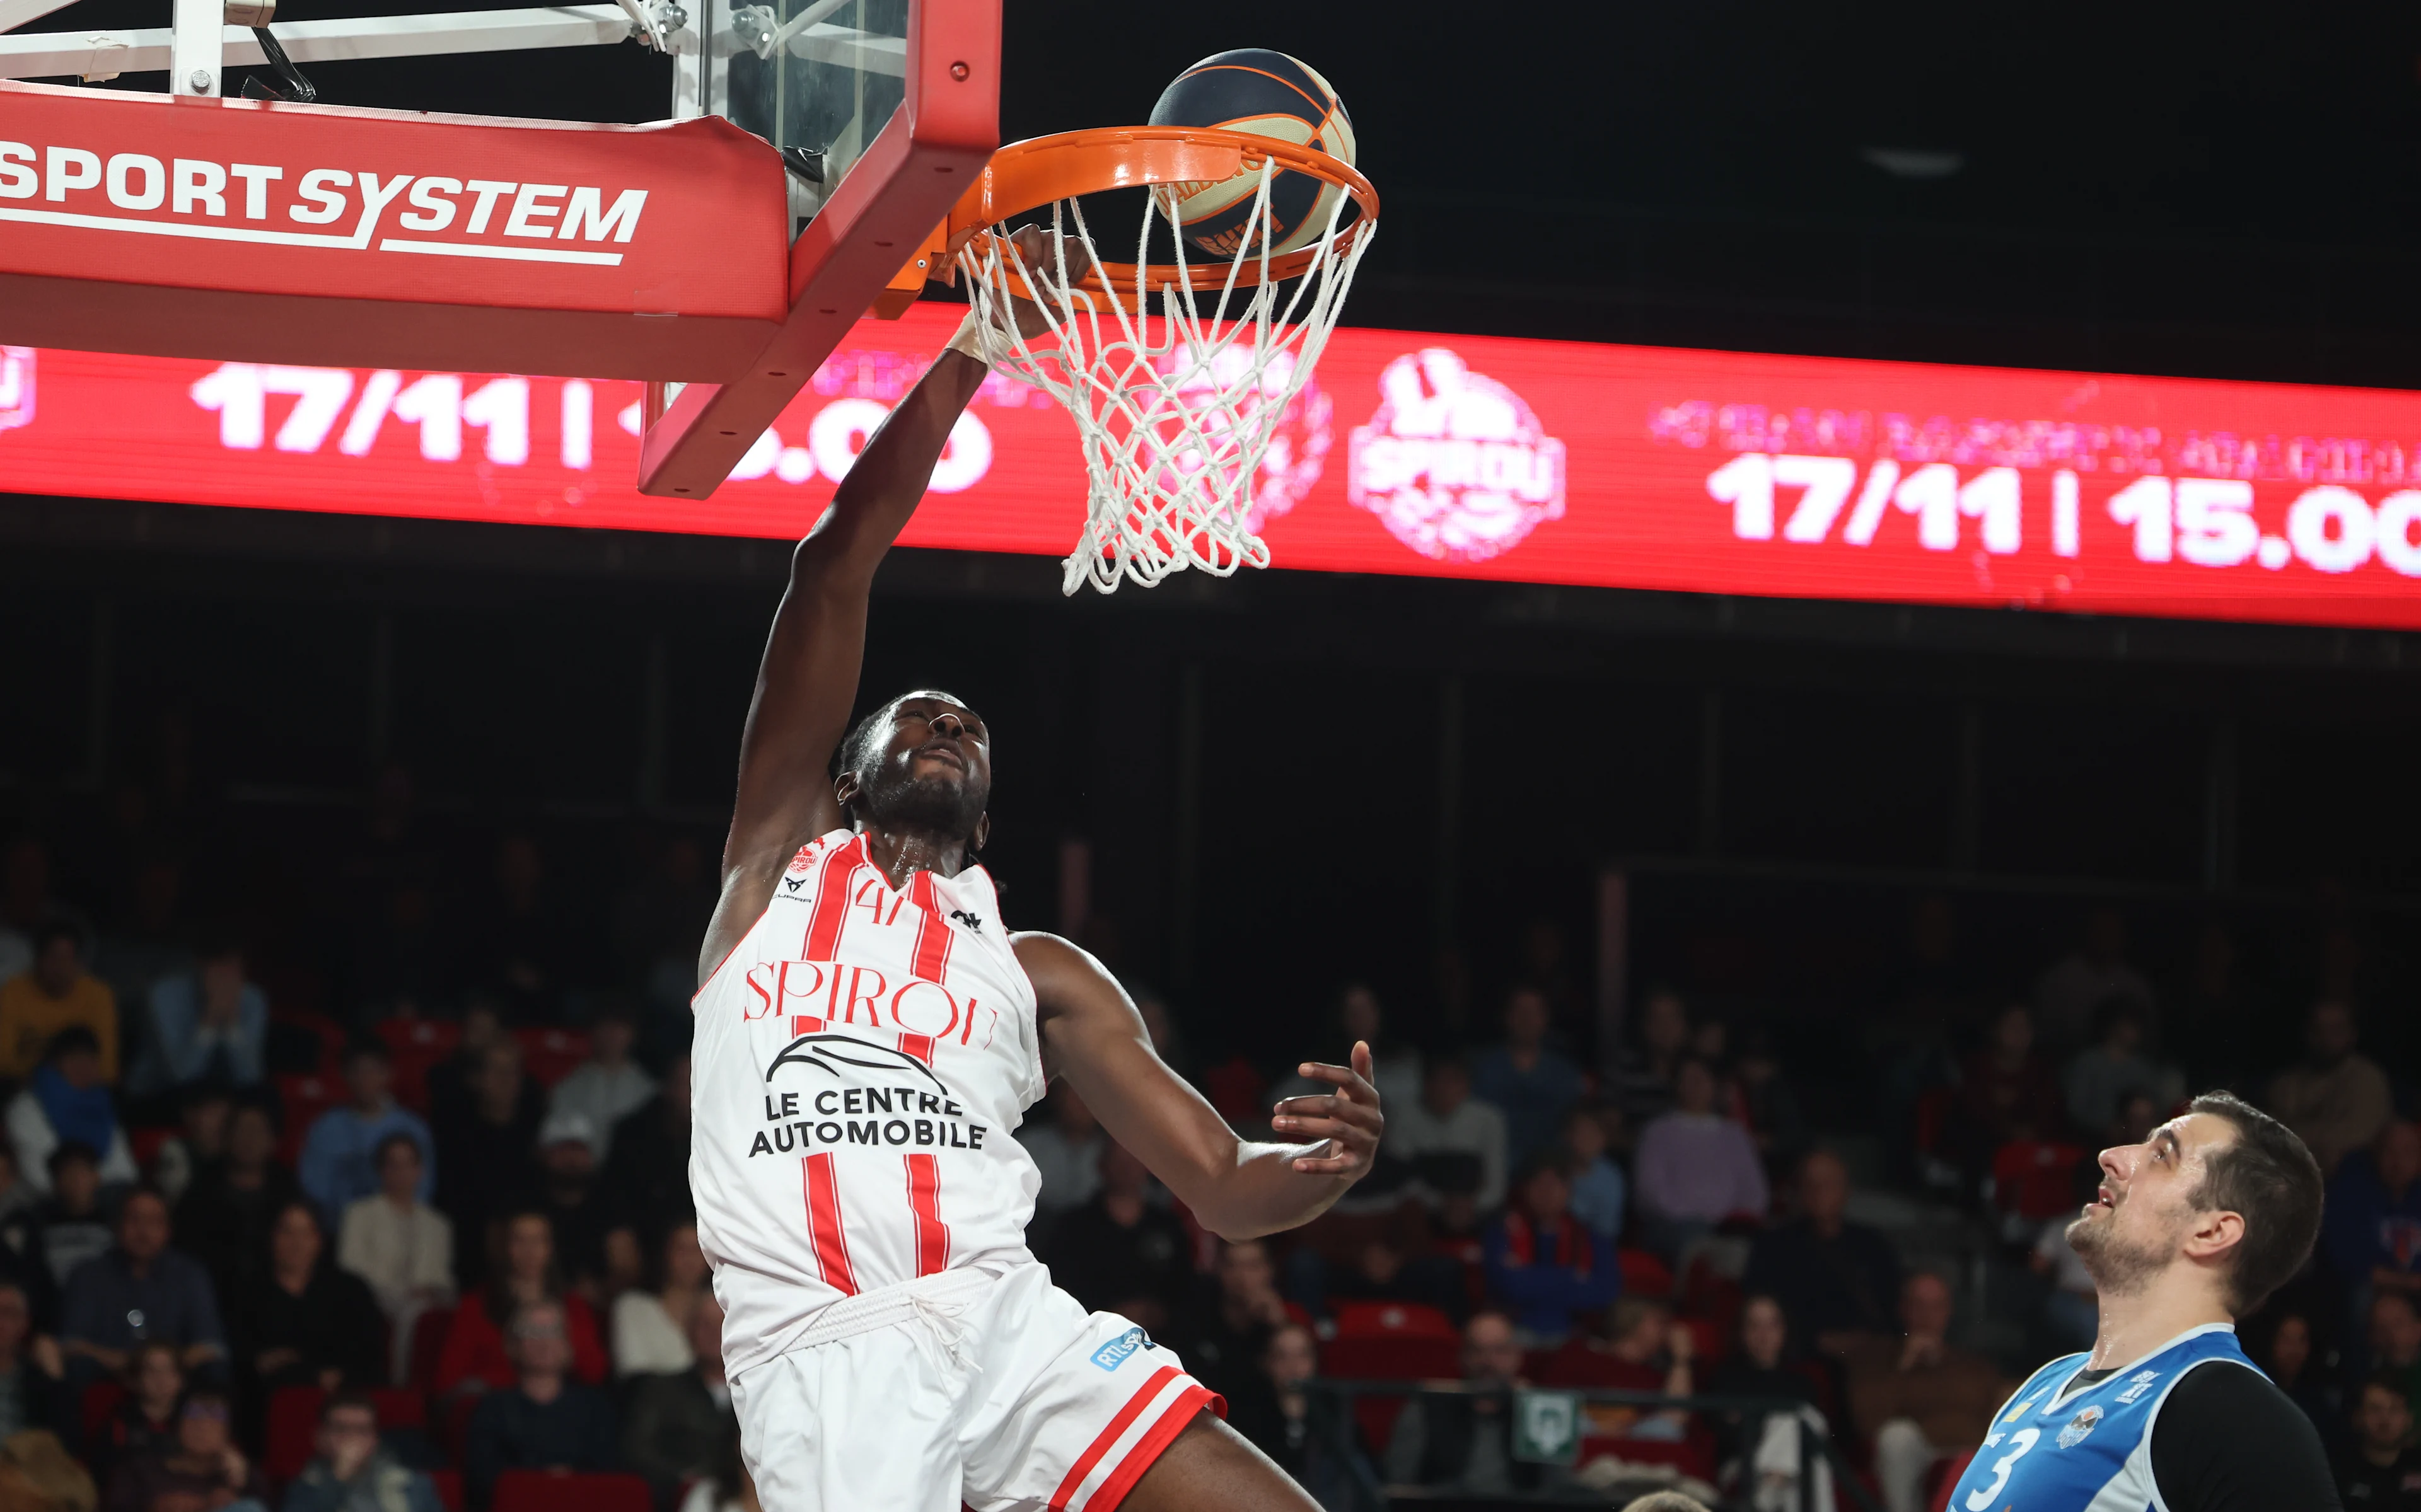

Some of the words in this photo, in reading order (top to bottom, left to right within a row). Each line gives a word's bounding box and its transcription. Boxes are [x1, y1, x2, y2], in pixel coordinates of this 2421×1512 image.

[0, 142, 283, 220] SPORT
[289, 168, 648, 250] SYSTEM
[190, 362, 528, 467] 17/11
[1707, 452, 2023, 555] 17/11
[748, 1119, 987, 1158] AUTOMOBILE
[765, 1092, 799, 1121] LE
[815, 1087, 963, 1117] CENTRE
[1965, 1428, 2041, 1512] 3
